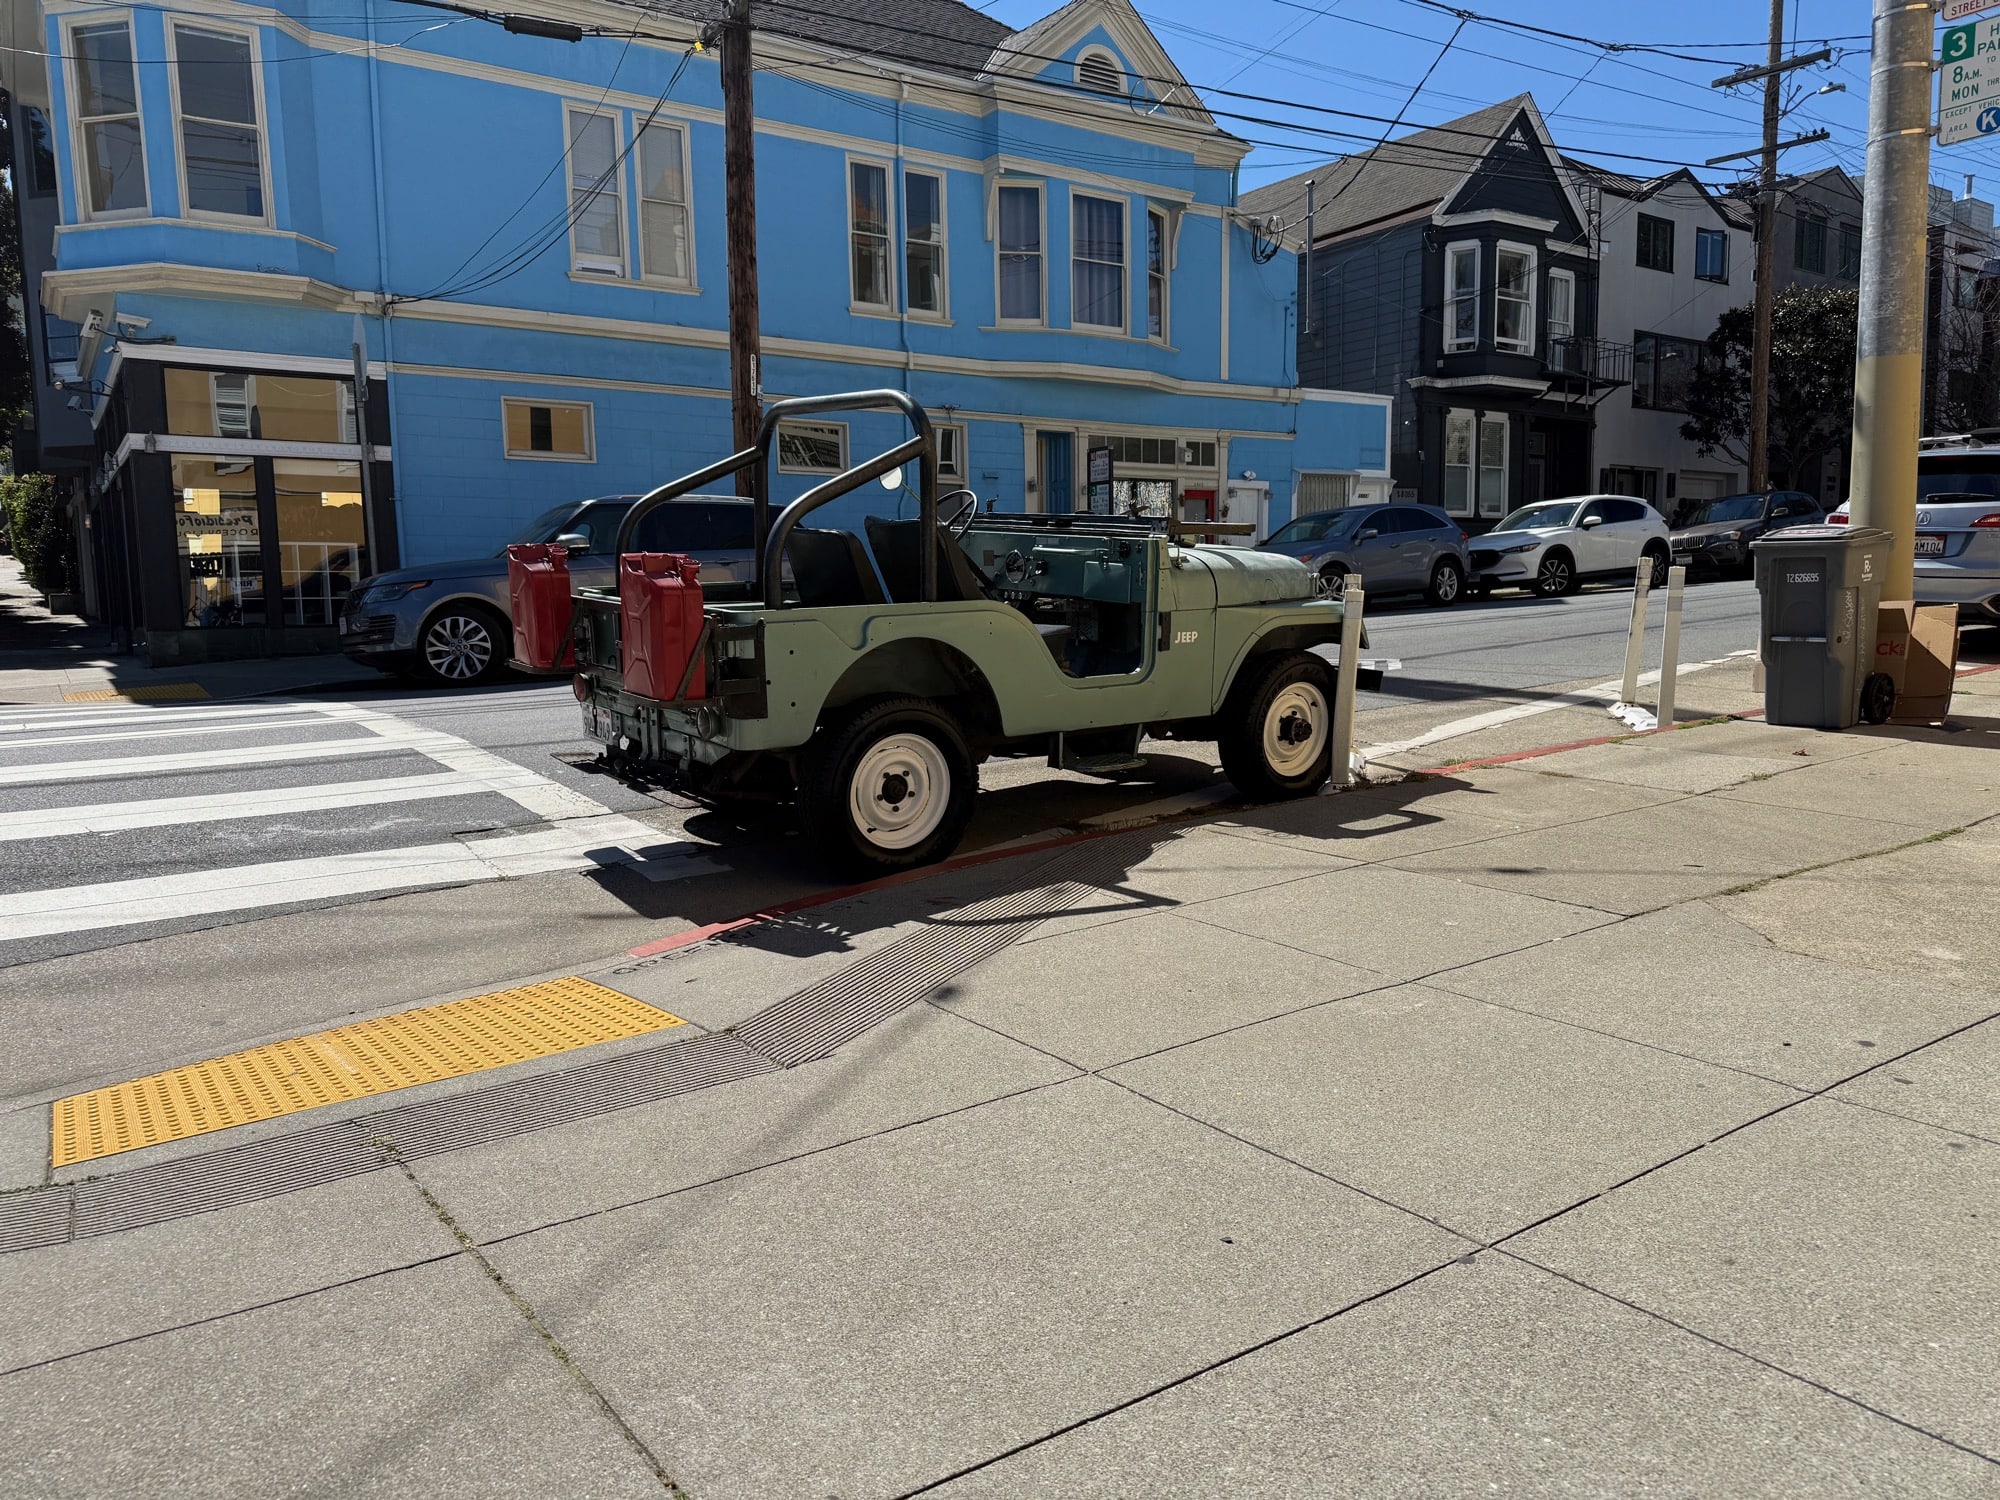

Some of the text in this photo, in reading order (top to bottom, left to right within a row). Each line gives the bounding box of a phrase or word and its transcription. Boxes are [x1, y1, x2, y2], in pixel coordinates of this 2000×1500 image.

[1949, 31, 1967, 57] 3
[1986, 55, 1997, 64] TO
[1951, 83, 1979, 102] MON
[1945, 105, 1972, 119] EXCEPT
[1948, 110, 1997, 133] AREA K
[1174, 631, 1199, 644] JEEP
